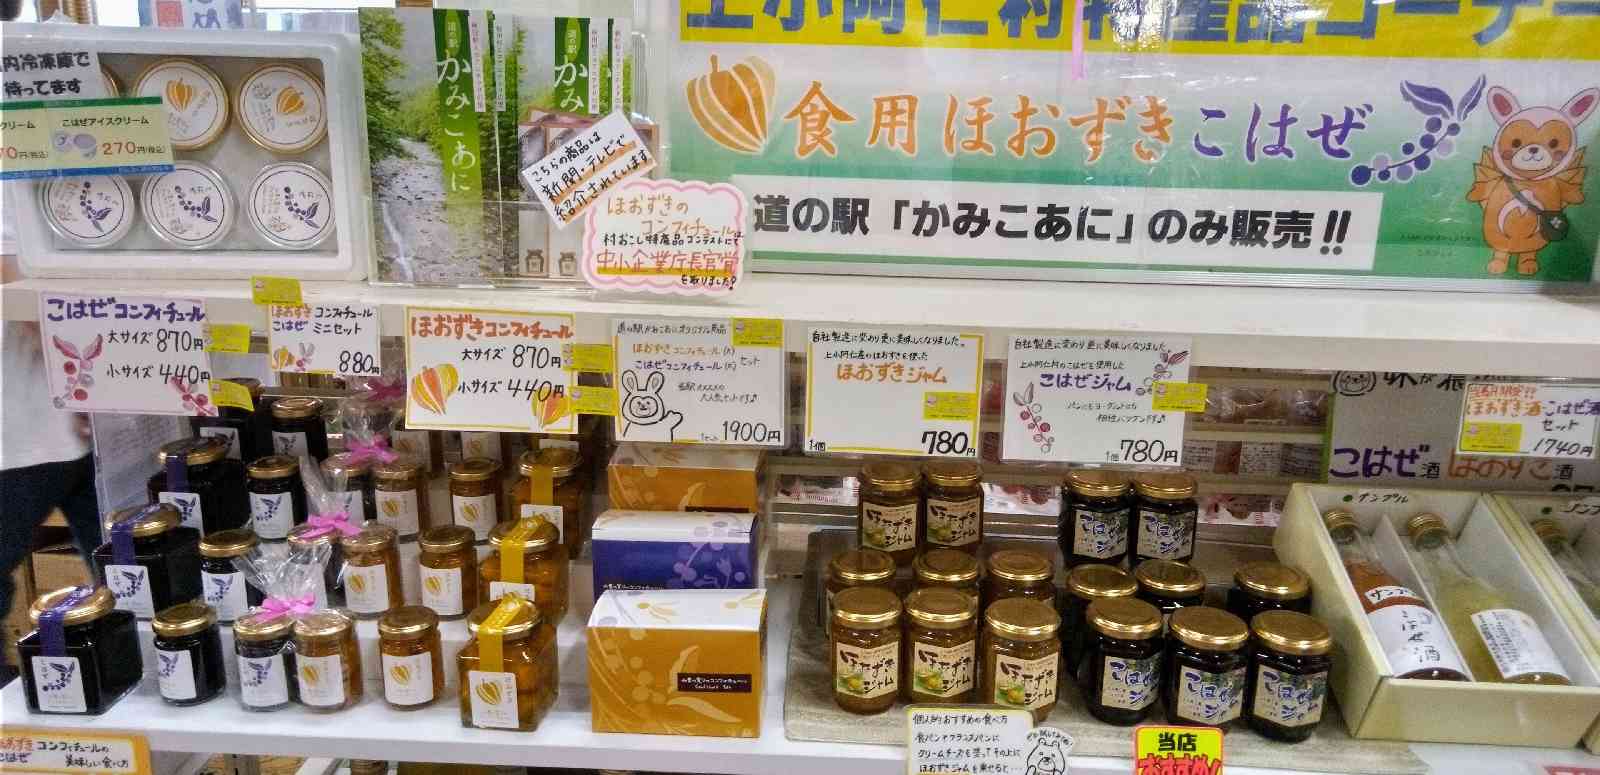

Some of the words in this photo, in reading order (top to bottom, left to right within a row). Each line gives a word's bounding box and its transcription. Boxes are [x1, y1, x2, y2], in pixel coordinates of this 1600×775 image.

[0, 51, 91, 72] 内冷凍庫で
[5, 78, 82, 98] 待ってます
[62, 116, 150, 128] こはぜアイスクリーム
[436, 48, 478, 191] かみこあに
[607, 193, 689, 217] ほおずきの
[596, 248, 740, 274] 中小企業庁長官賞
[47, 297, 205, 323] こはぜコンフィチュール
[314, 306, 373, 319] コンフィチュール
[272, 319, 308, 332] こはぜ
[313, 321, 362, 335] ミニセット
[411, 313, 574, 341] ほおずきコンフィチュール
[108, 329, 153, 345] 大サイズ
[156, 328, 204, 353] 870円
[339, 350, 380, 375] 880円
[461, 347, 506, 361] 大サイズ
[512, 344, 561, 369] 870円
[105, 364, 153, 378] 小サイズ
[159, 364, 210, 385] 440円
[836, 361, 948, 384] ほおずきジャム
[1039, 372, 1132, 392] こはぜジャム
[458, 379, 502, 394] 小サイズ
[507, 378, 565, 402] 440円
[722, 420, 781, 442] 1900円
[1542, 418, 1579, 432] セット
[1120, 439, 1179, 463] 780円
[1533, 438, 1594, 457] 1740円
[1329, 443, 1441, 479] こはぜ酒
[1158, 731, 1199, 752] 当店
